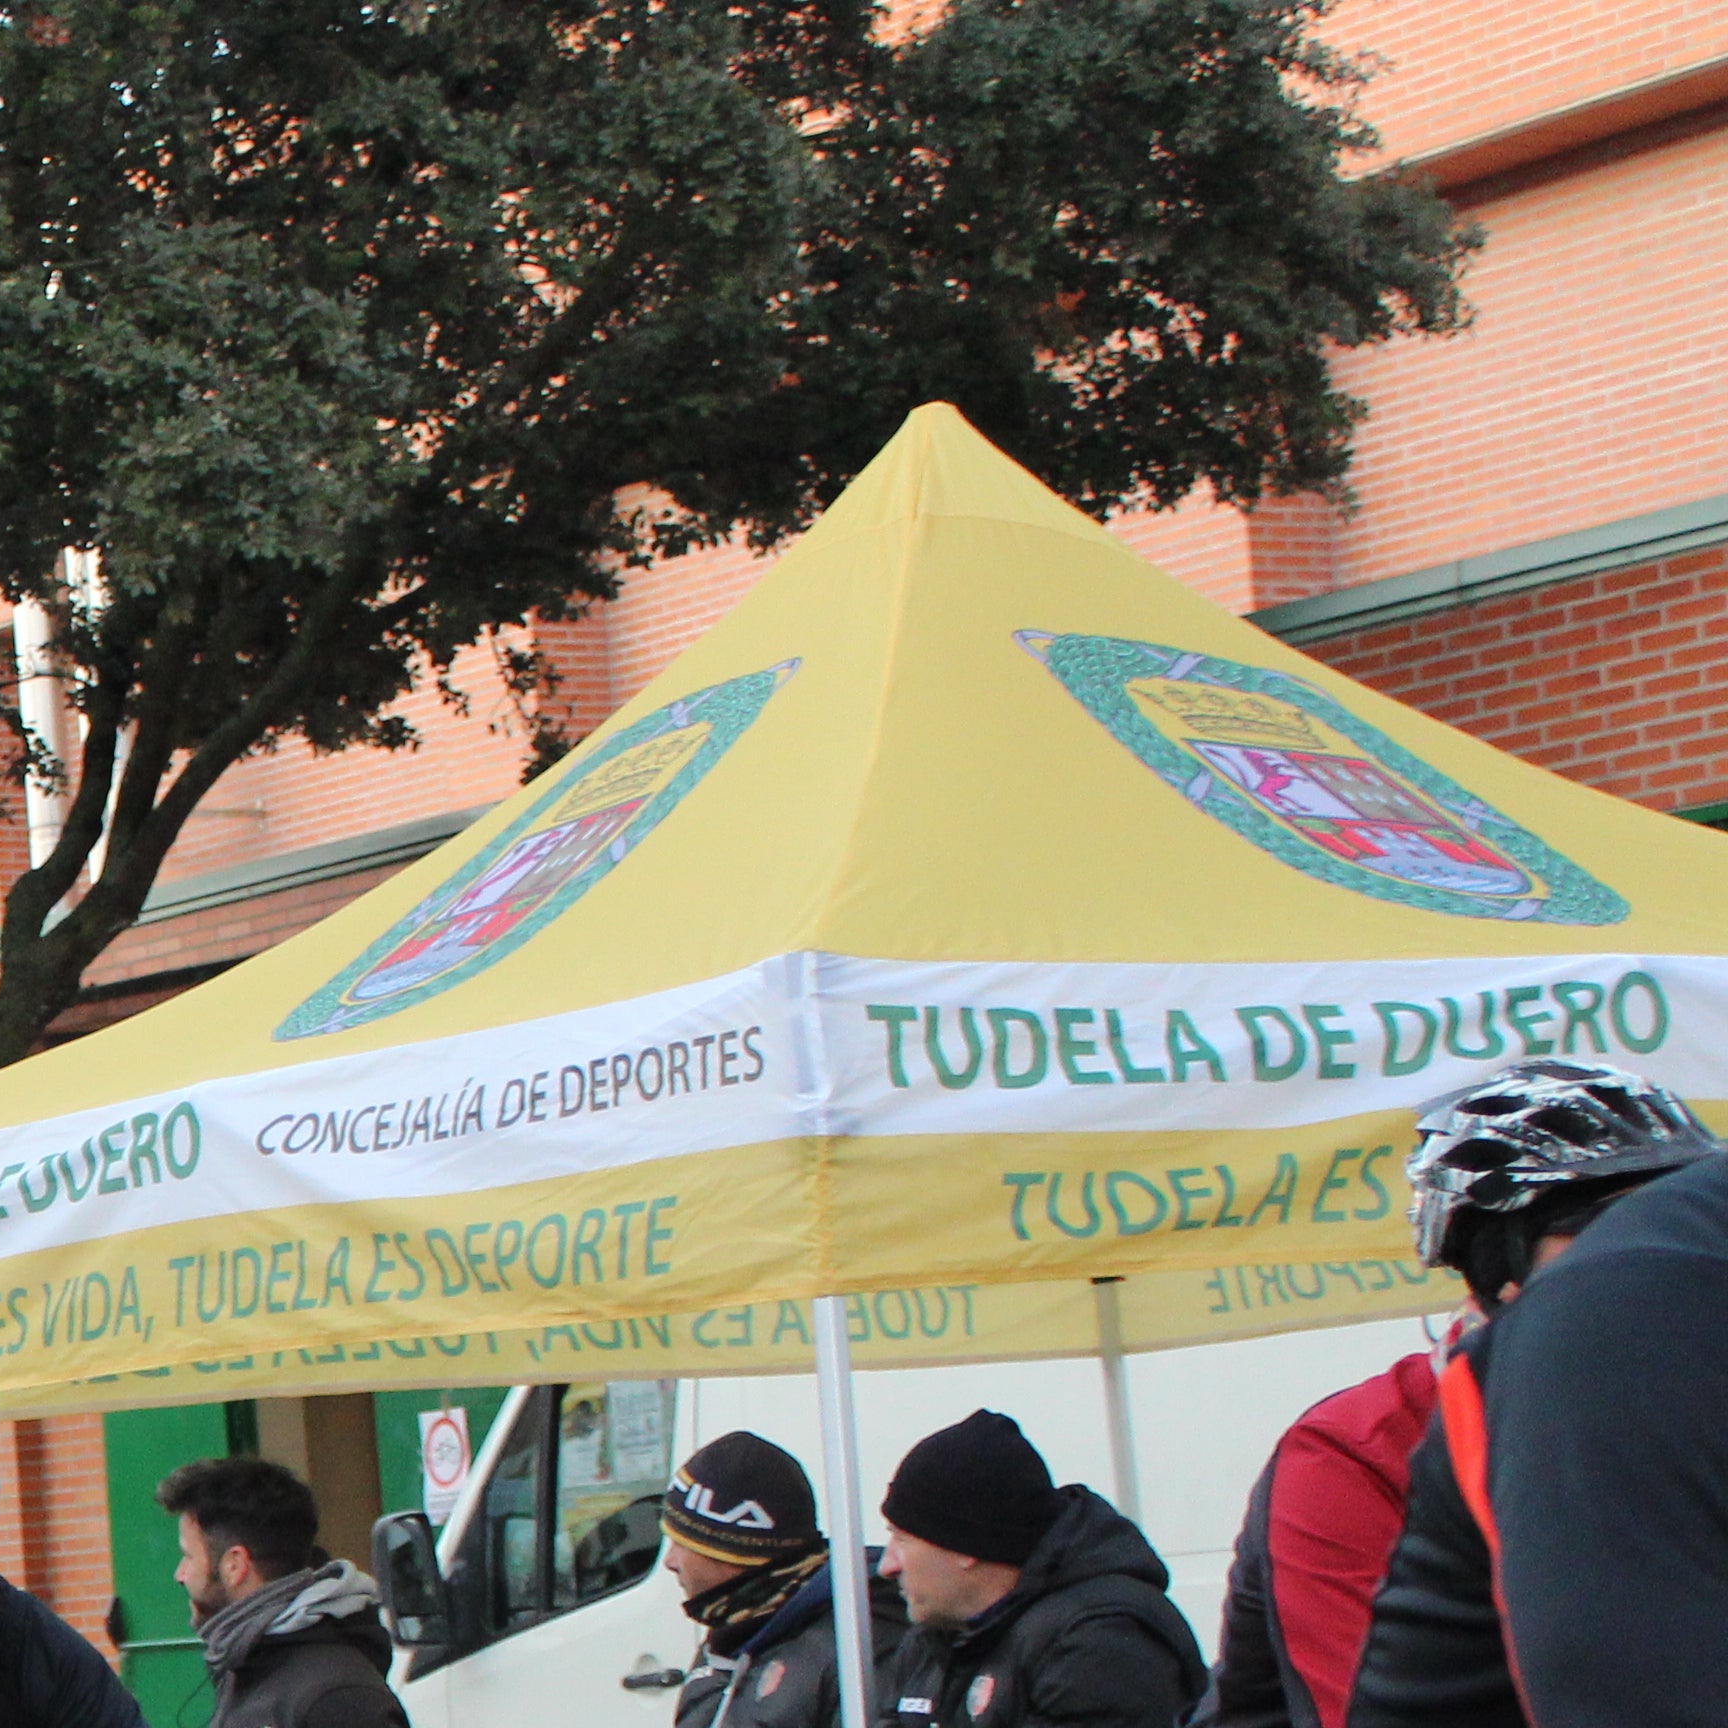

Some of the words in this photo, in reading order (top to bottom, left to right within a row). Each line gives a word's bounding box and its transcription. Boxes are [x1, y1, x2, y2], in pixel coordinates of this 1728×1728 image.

[867, 1003, 1229, 1090] TUDELA
[1236, 1004, 1359, 1084] DE
[1373, 970, 1670, 1078] DUERO
[255, 1078, 486, 1156] CONCEJALÍA
[495, 1071, 550, 1128] DE
[558, 1025, 764, 1118] DEPORTES
[18, 1101, 202, 1213] DUERO
[1002, 1152, 1302, 1241] TUDELA
[1309, 1144, 1393, 1223] ES
[43, 1266, 155, 1347] VIDA,
[168, 1236, 350, 1325] TUDELA
[366, 1229, 425, 1304] ES
[423, 1197, 677, 1297] DEPORTE
[667, 1474, 775, 1529] FILA
